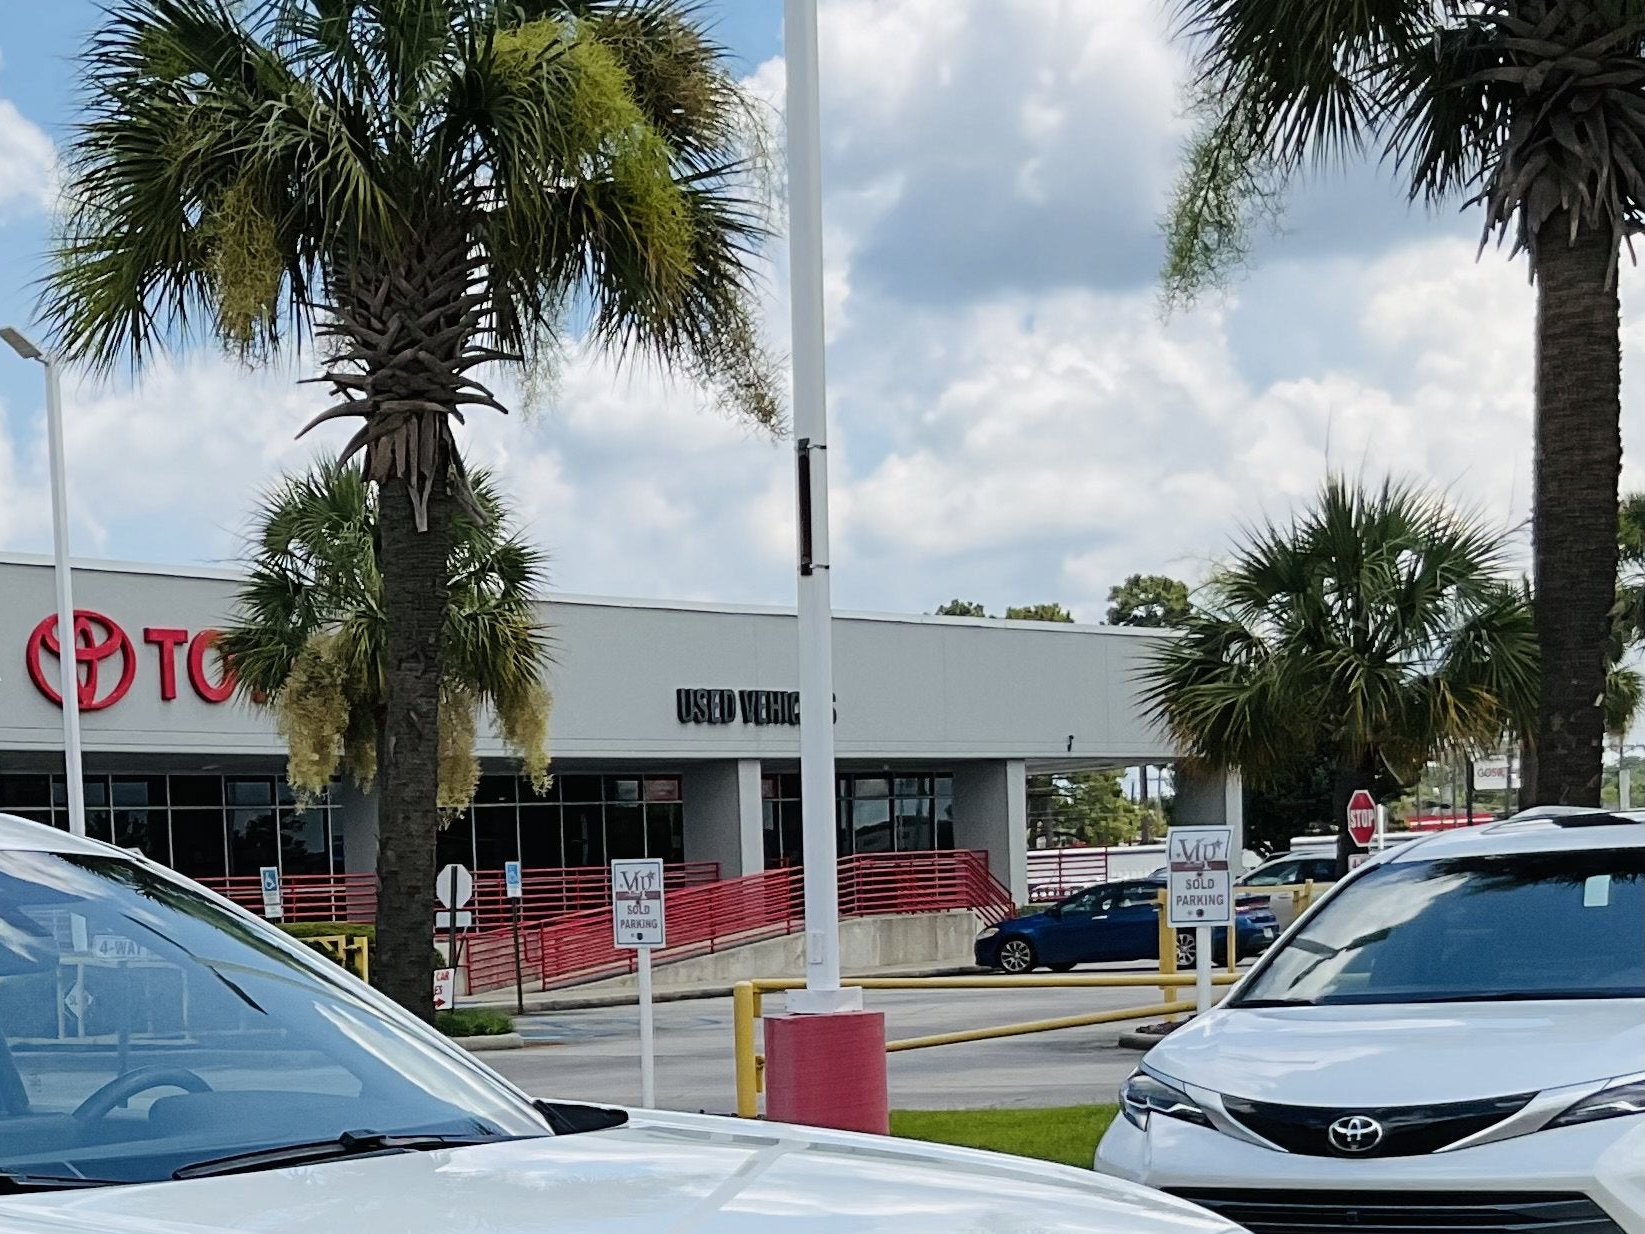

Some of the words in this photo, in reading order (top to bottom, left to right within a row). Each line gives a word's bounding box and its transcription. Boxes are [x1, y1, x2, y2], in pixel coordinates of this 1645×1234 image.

[676, 688, 737, 725] USED
[738, 690, 837, 726] VEHIC
[1350, 809, 1374, 828] STOP
[1185, 878, 1215, 890] SOLD
[1176, 895, 1224, 906] PARKING
[627, 904, 650, 915] SOLD
[620, 919, 658, 929] PARKING
[436, 970, 449, 981] CAR
